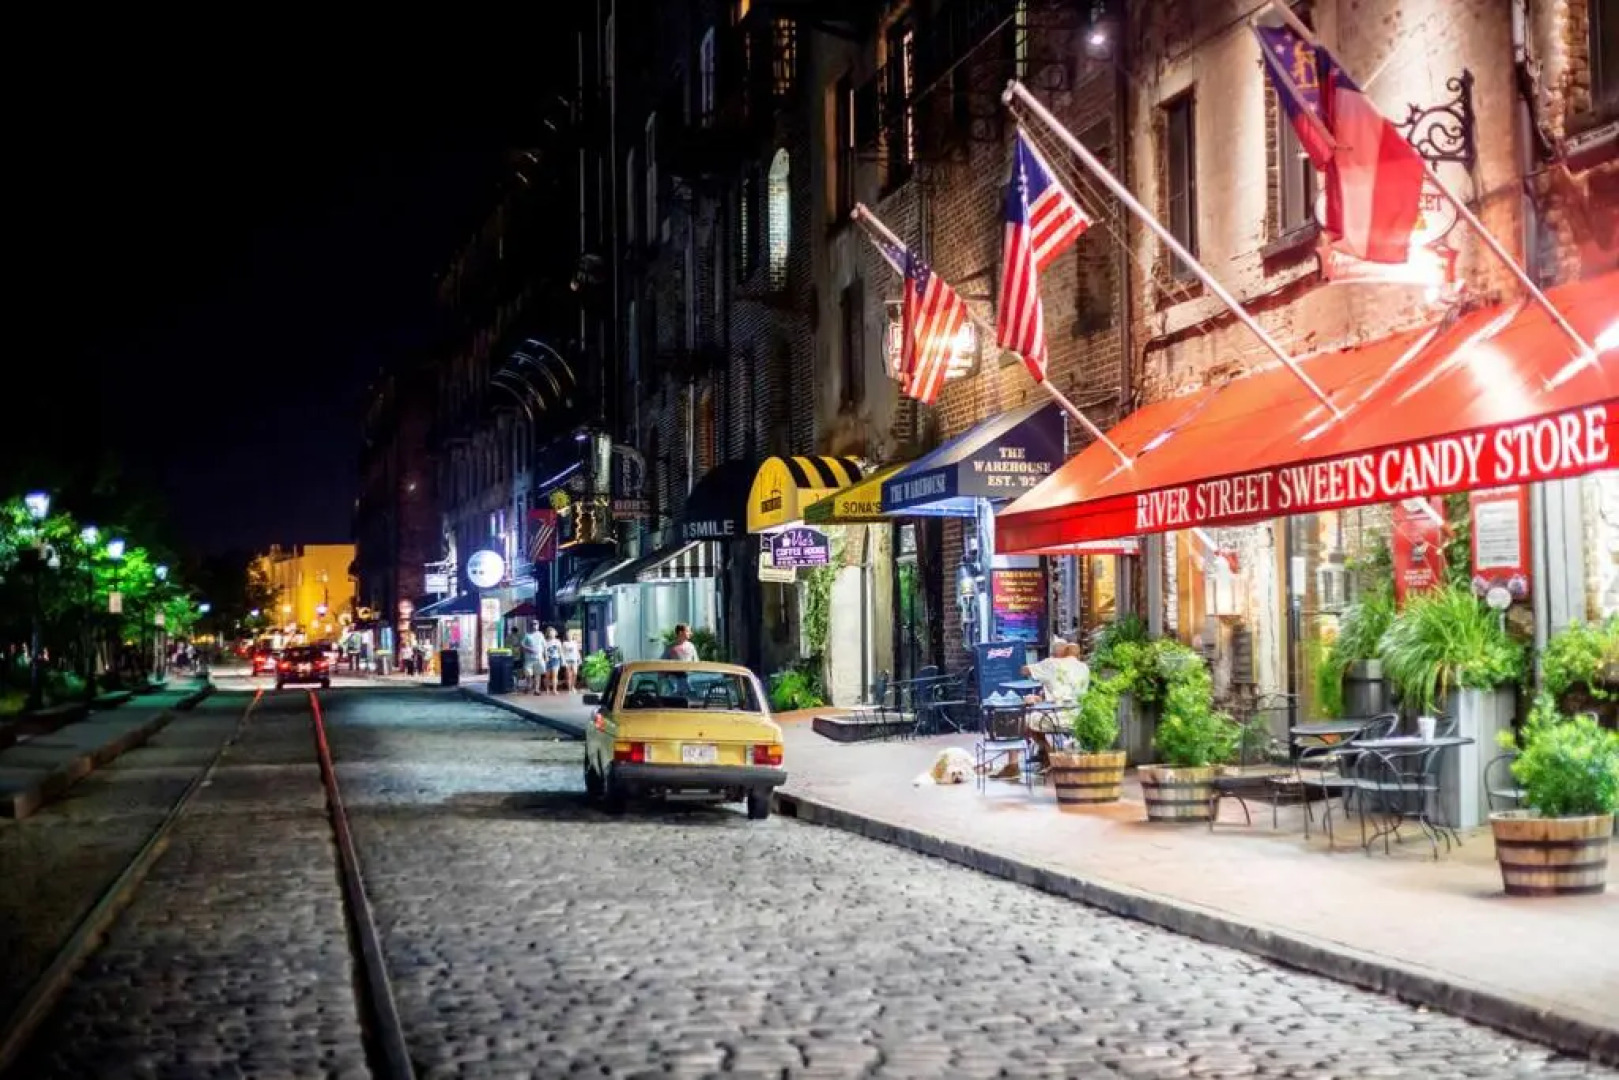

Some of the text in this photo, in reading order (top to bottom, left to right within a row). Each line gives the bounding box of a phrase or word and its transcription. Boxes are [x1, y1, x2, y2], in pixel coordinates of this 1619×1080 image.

[999, 447, 1025, 458] THE
[973, 461, 1051, 474] WAREHOUSE
[1136, 407, 1610, 529] RIVER STREET SWEETS CANDY STORE
[889, 474, 946, 503] THE WAREHOUSE
[987, 476, 1015, 488] EST.
[842, 500, 883, 514] SONA'S
[688, 519, 735, 537] SMILE
